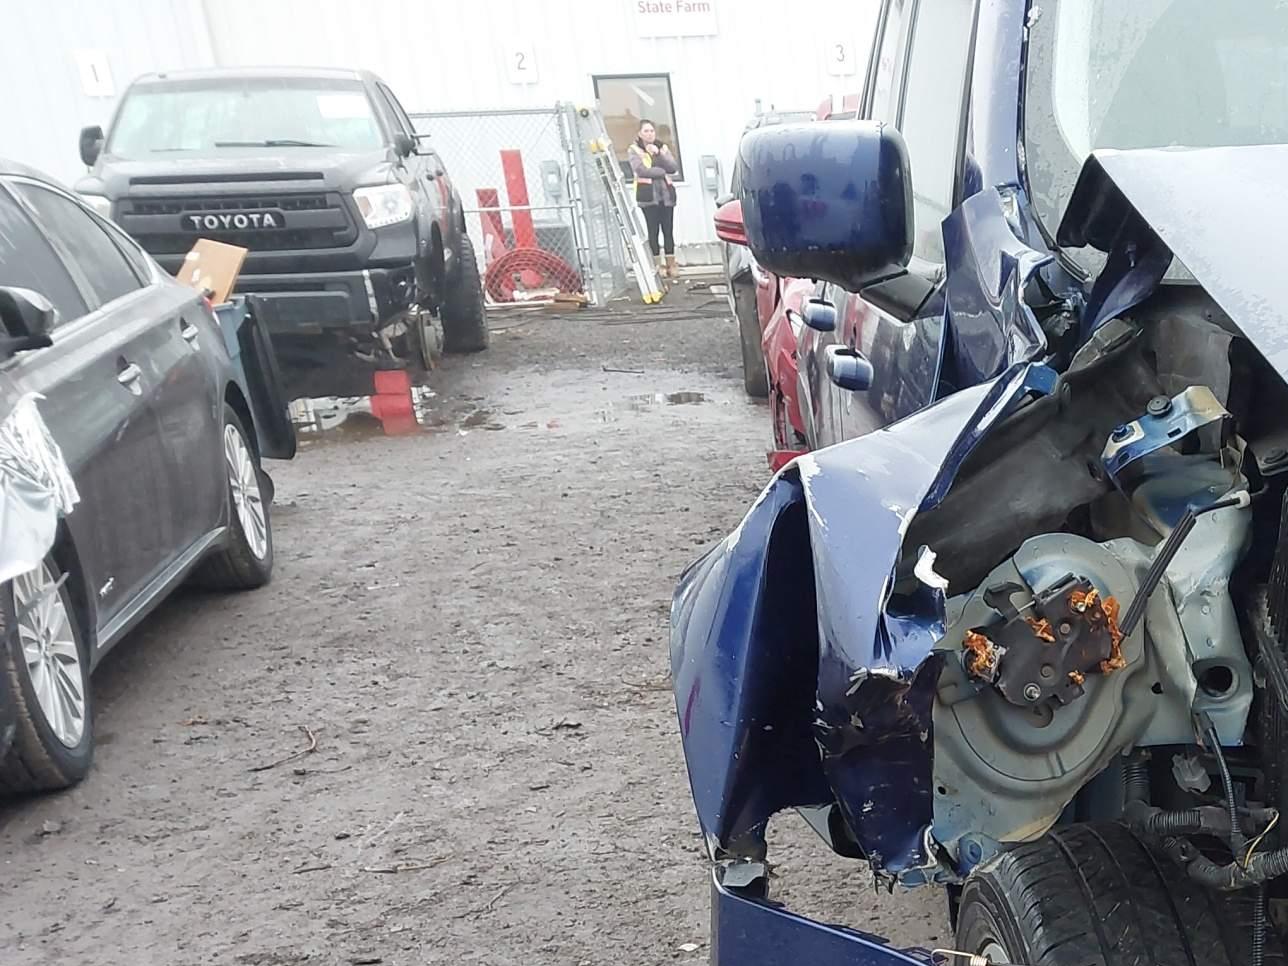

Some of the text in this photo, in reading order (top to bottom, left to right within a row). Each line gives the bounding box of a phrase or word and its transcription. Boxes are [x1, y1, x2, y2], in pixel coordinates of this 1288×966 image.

[638, 0, 710, 13] State Farm
[515, 52, 527, 70] 2
[835, 44, 845, 62] 3
[190, 213, 276, 230] TOYOTA
